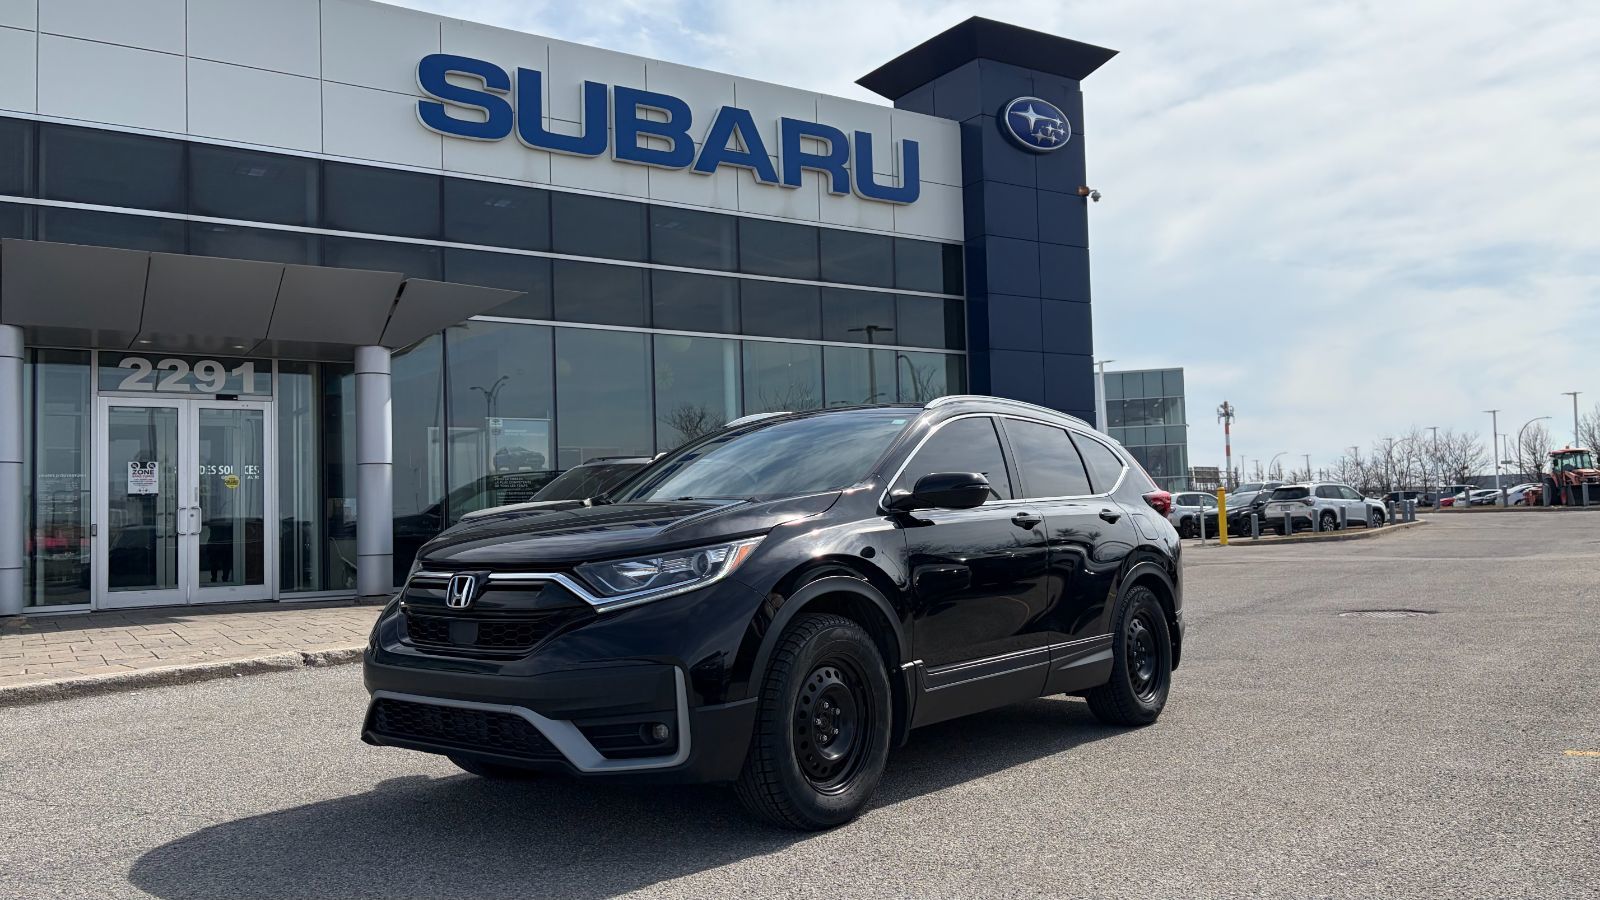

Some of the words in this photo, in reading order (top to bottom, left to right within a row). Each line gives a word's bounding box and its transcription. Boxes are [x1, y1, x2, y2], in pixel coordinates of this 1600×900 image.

[416, 53, 920, 205] SUBARU
[118, 356, 255, 394] 2291
[218, 465, 260, 475] SOCES
